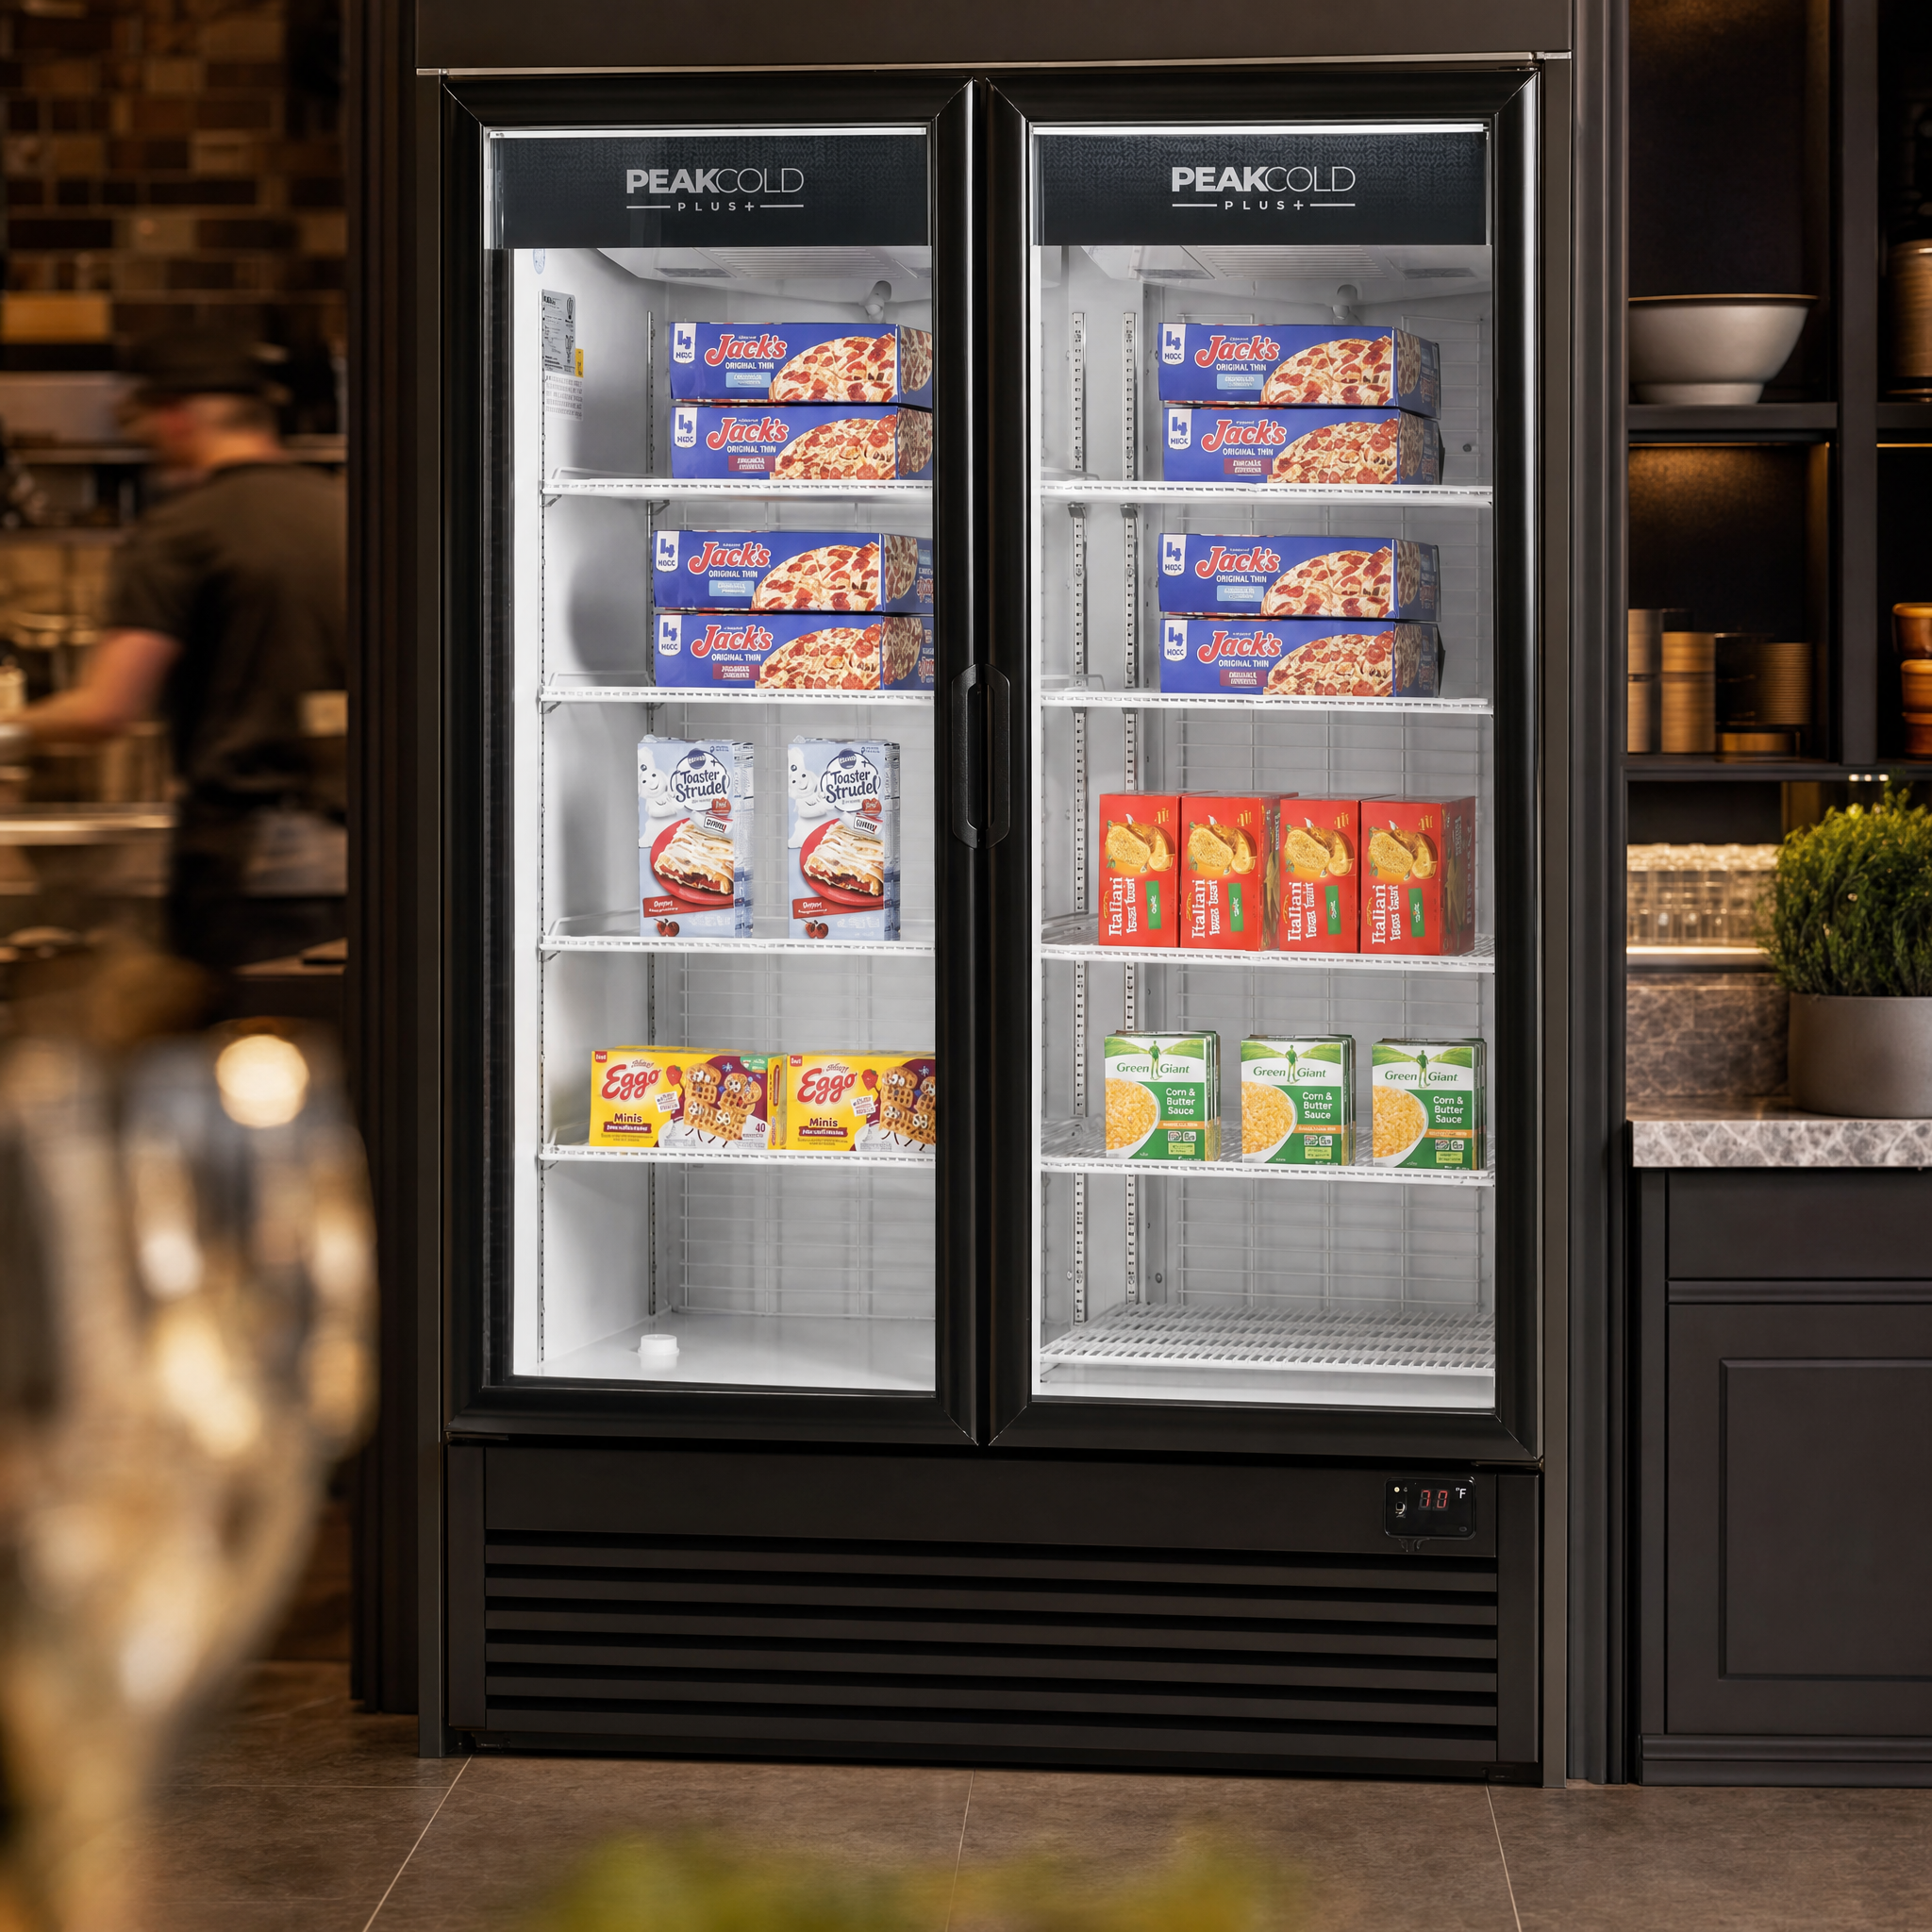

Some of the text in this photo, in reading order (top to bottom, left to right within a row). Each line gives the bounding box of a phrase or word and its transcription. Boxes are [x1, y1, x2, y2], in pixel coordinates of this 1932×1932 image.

[626, 168, 804, 194] PEAKCOLD
[1172, 166, 1356, 192] PEAKCOLD
[705, 334, 788, 367] Jack's
[1194, 335, 1281, 369] Jack's
[707, 416, 790, 451] Jack's
[1201, 419, 1287, 452] Jack's
[688, 541, 771, 575] Jack's
[1195, 546, 1281, 579] Jack's
[691, 625, 774, 658] Jack's
[1197, 630, 1282, 664] Jack's
[679, 770, 720, 785] Toaster
[830, 770, 871, 785] Toaster
[675, 774, 726, 803] Strudel
[825, 774, 877, 804] Strudel
[1116, 1062, 1190, 1074] Green Giant
[1253, 1066, 1326, 1077] Green Giant
[601, 1064, 661, 1101] Eggo
[1384, 1071, 1457, 1082] Green Giant
[797, 1067, 858, 1105] Eggo
[1166, 1088, 1195, 1096] Corn &
[1166, 1097, 1195, 1106] Butter
[1302, 1091, 1332, 1100] Corn &
[1433, 1096, 1463, 1105] Corn &
[1168, 1107, 1194, 1115] Sauce
[1304, 1101, 1333, 1110] Butter
[1434, 1106, 1464, 1114] Butter
[614, 1113, 642, 1124] Minis
[809, 1117, 838, 1127] Minis
[1304, 1110, 1331, 1119] Sauce
[1435, 1115, 1462, 1124] Sauce
[756, 1124, 766, 1133] 40
